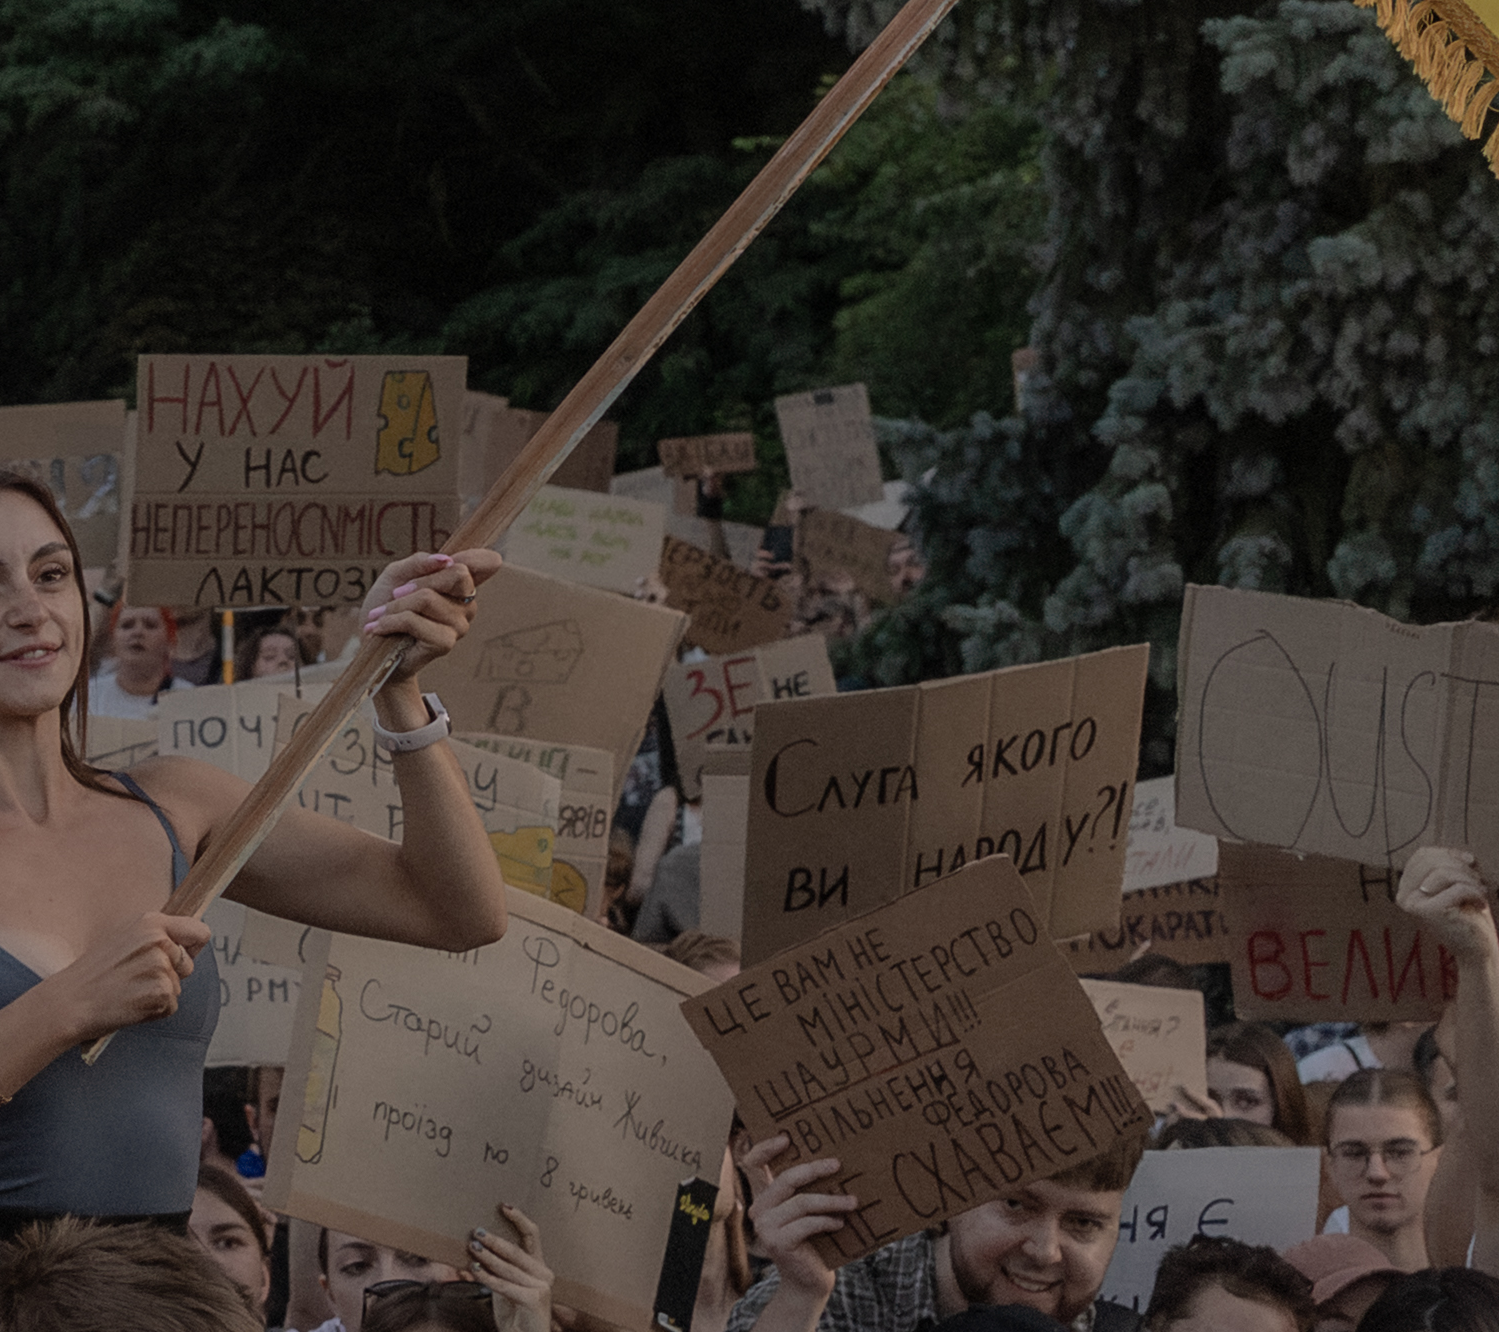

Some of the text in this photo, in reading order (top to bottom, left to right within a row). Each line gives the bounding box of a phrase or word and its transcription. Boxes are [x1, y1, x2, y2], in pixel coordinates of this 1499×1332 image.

[145, 356, 357, 442] НАХУЙ
[175, 441, 329, 492] У НАС
[194, 563, 372, 605] ЛАКТОЗ
[773, 670, 811, 700] НЕ
[782, 864, 850, 914] ВИ
[705, 926, 892, 1040] ЦЕ ВАМ НЕ
[795, 906, 1041, 1048] МІНІСТЕРСТВО
[359, 977, 493, 1065] Старий
[519, 1057, 604, 1112] дизайн
[921, 1046, 1091, 1138] ФЕДОРОВА
[371, 1096, 454, 1157] проїзд
[483, 1142, 509, 1166] по
[538, 1155, 559, 1187] 8
